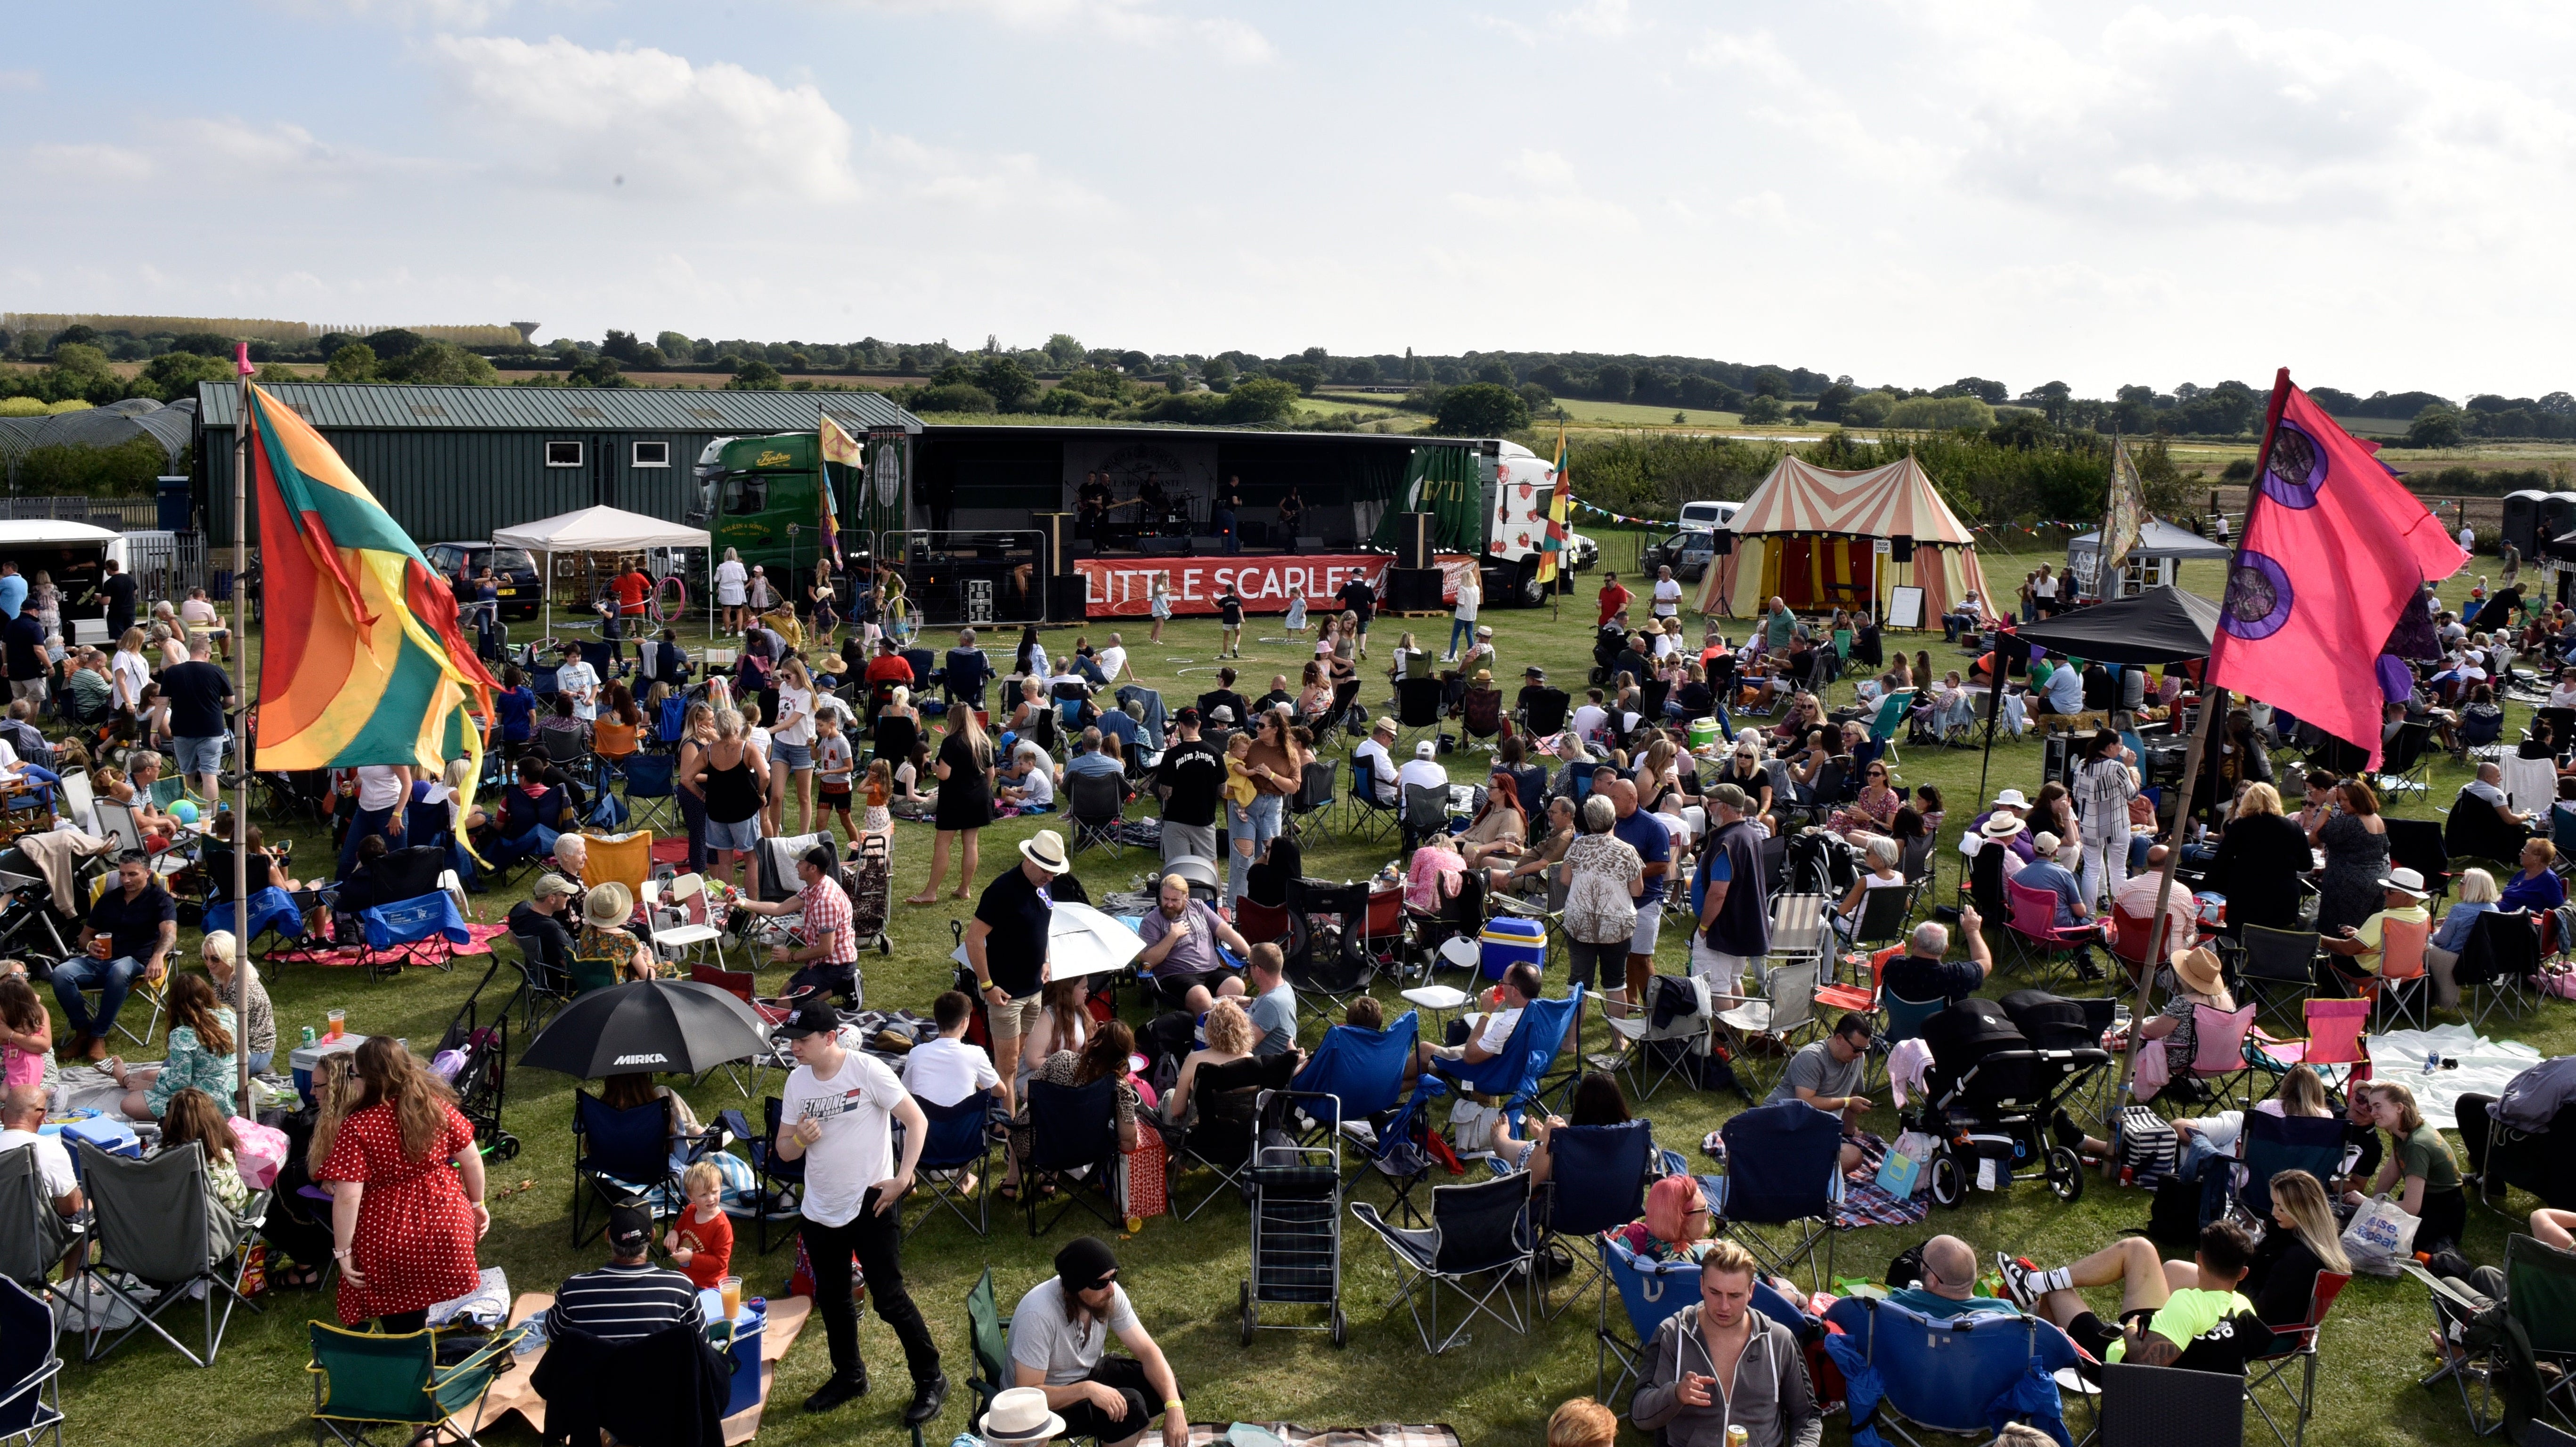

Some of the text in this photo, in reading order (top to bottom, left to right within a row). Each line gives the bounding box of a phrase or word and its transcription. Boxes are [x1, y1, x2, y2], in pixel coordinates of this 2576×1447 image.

[721, 523, 743, 534] WILKIN
[1086, 569, 1203, 603] LITTLE
[613, 1053, 668, 1065] MIRKA
[799, 1092, 848, 1114] DETHRONE
[823, 1107, 844, 1117] BRAND
